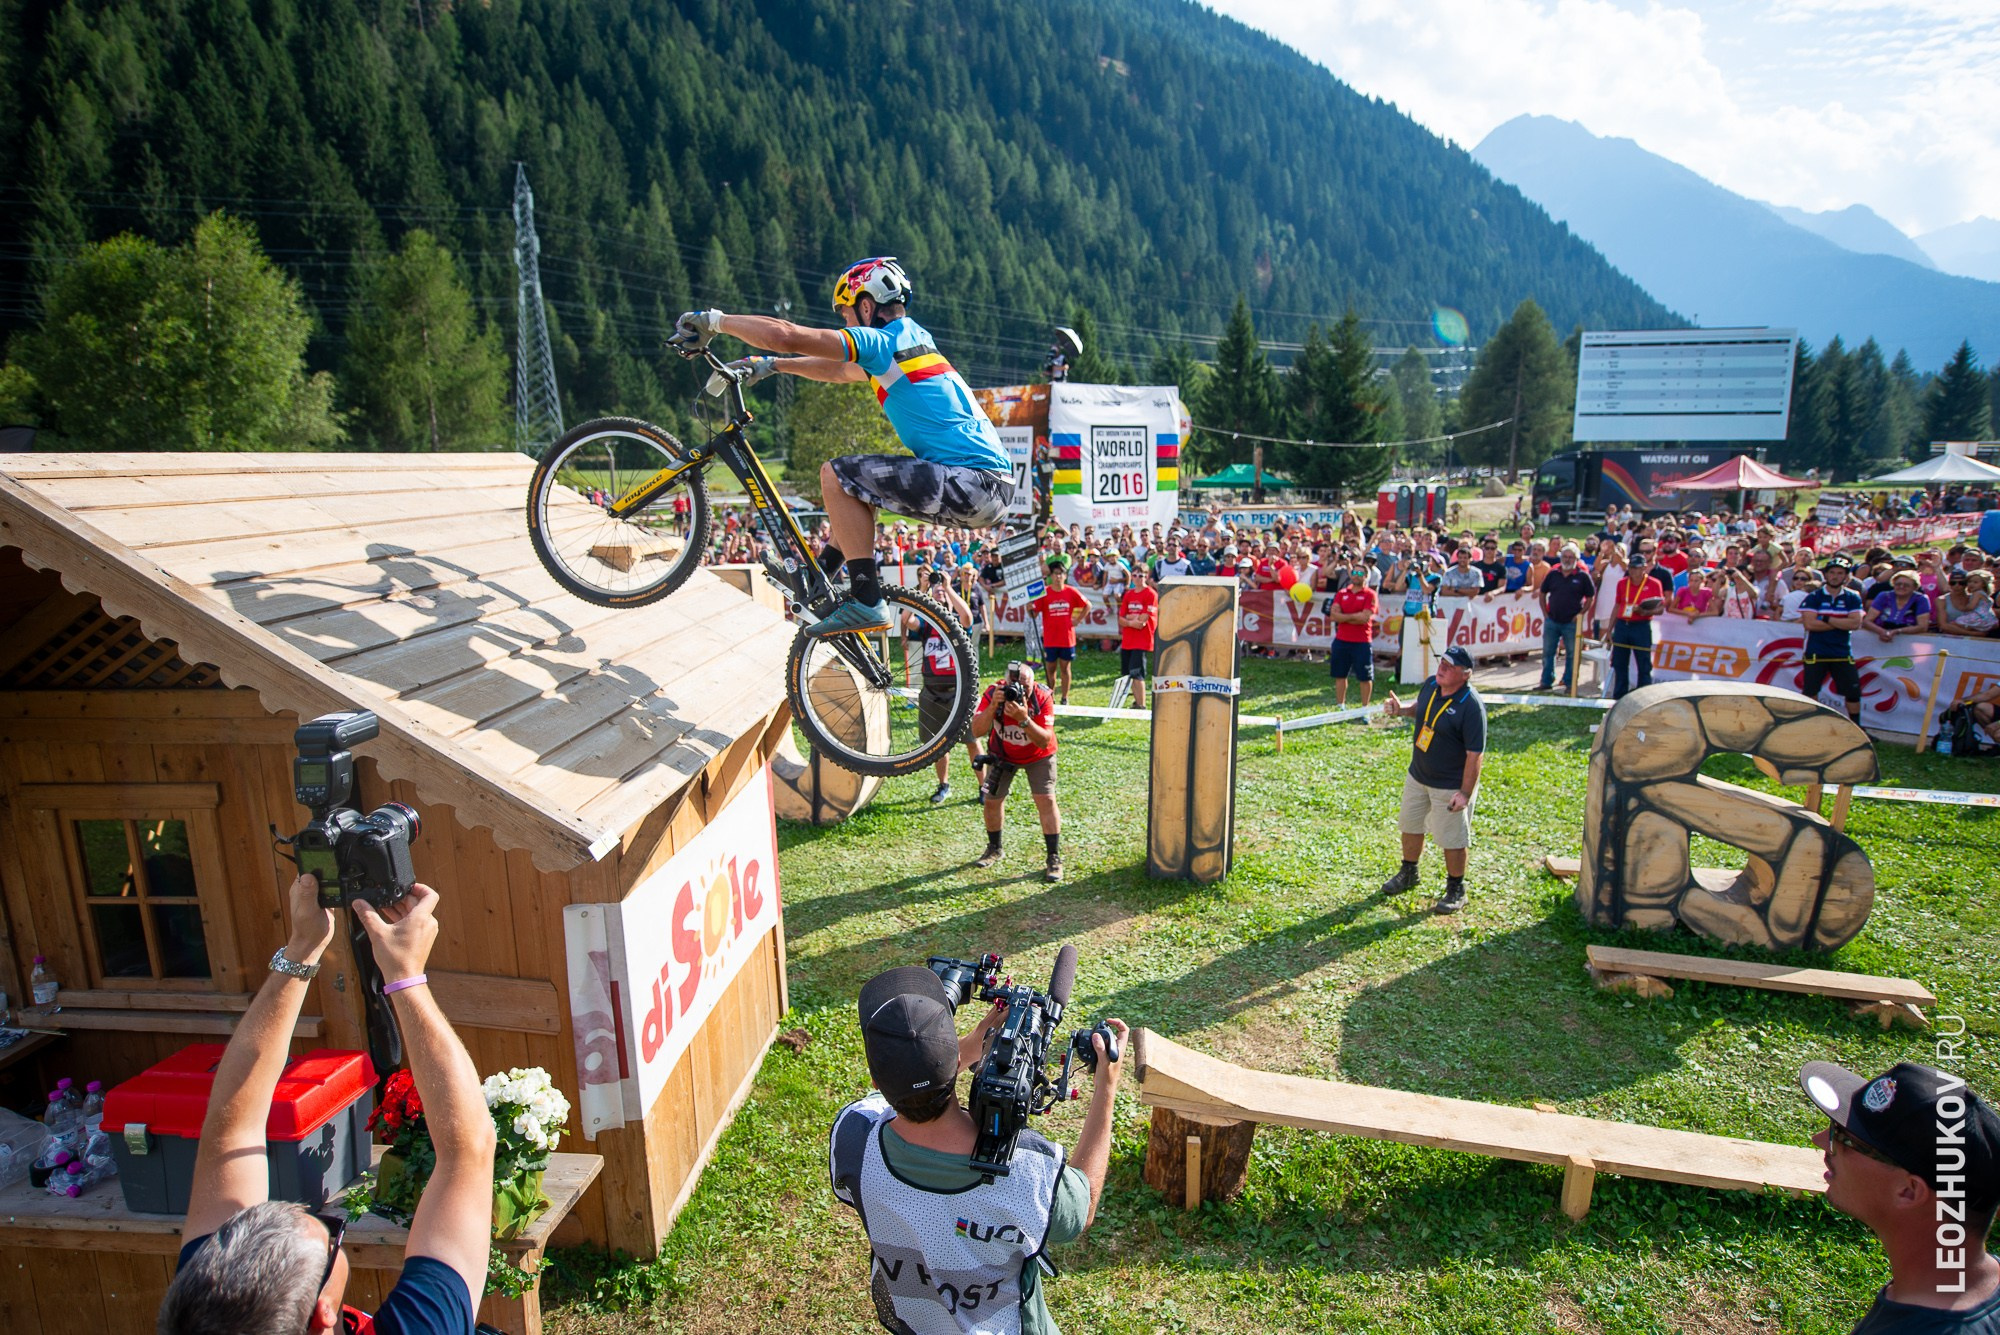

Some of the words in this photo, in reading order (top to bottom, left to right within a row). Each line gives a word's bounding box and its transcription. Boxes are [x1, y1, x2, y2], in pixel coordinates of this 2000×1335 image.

[1096, 440, 1143, 457] WORLD
[1640, 455, 1679, 464] WATCH
[1680, 455, 1691, 464] IT
[1692, 455, 1709, 464] ON
[1099, 472, 1143, 496] 2016
[1286, 600, 1332, 637] Val
[1436, 608, 1478, 647] Val
[1480, 622, 1496, 644] di
[1496, 606, 1543, 643] Sole
[1658, 642, 1738, 675] IPER
[641, 961, 673, 1064] di
[671, 854, 764, 1018] Sole
[969, 1221, 1026, 1245] UCI
[877, 1255, 903, 1282] V
